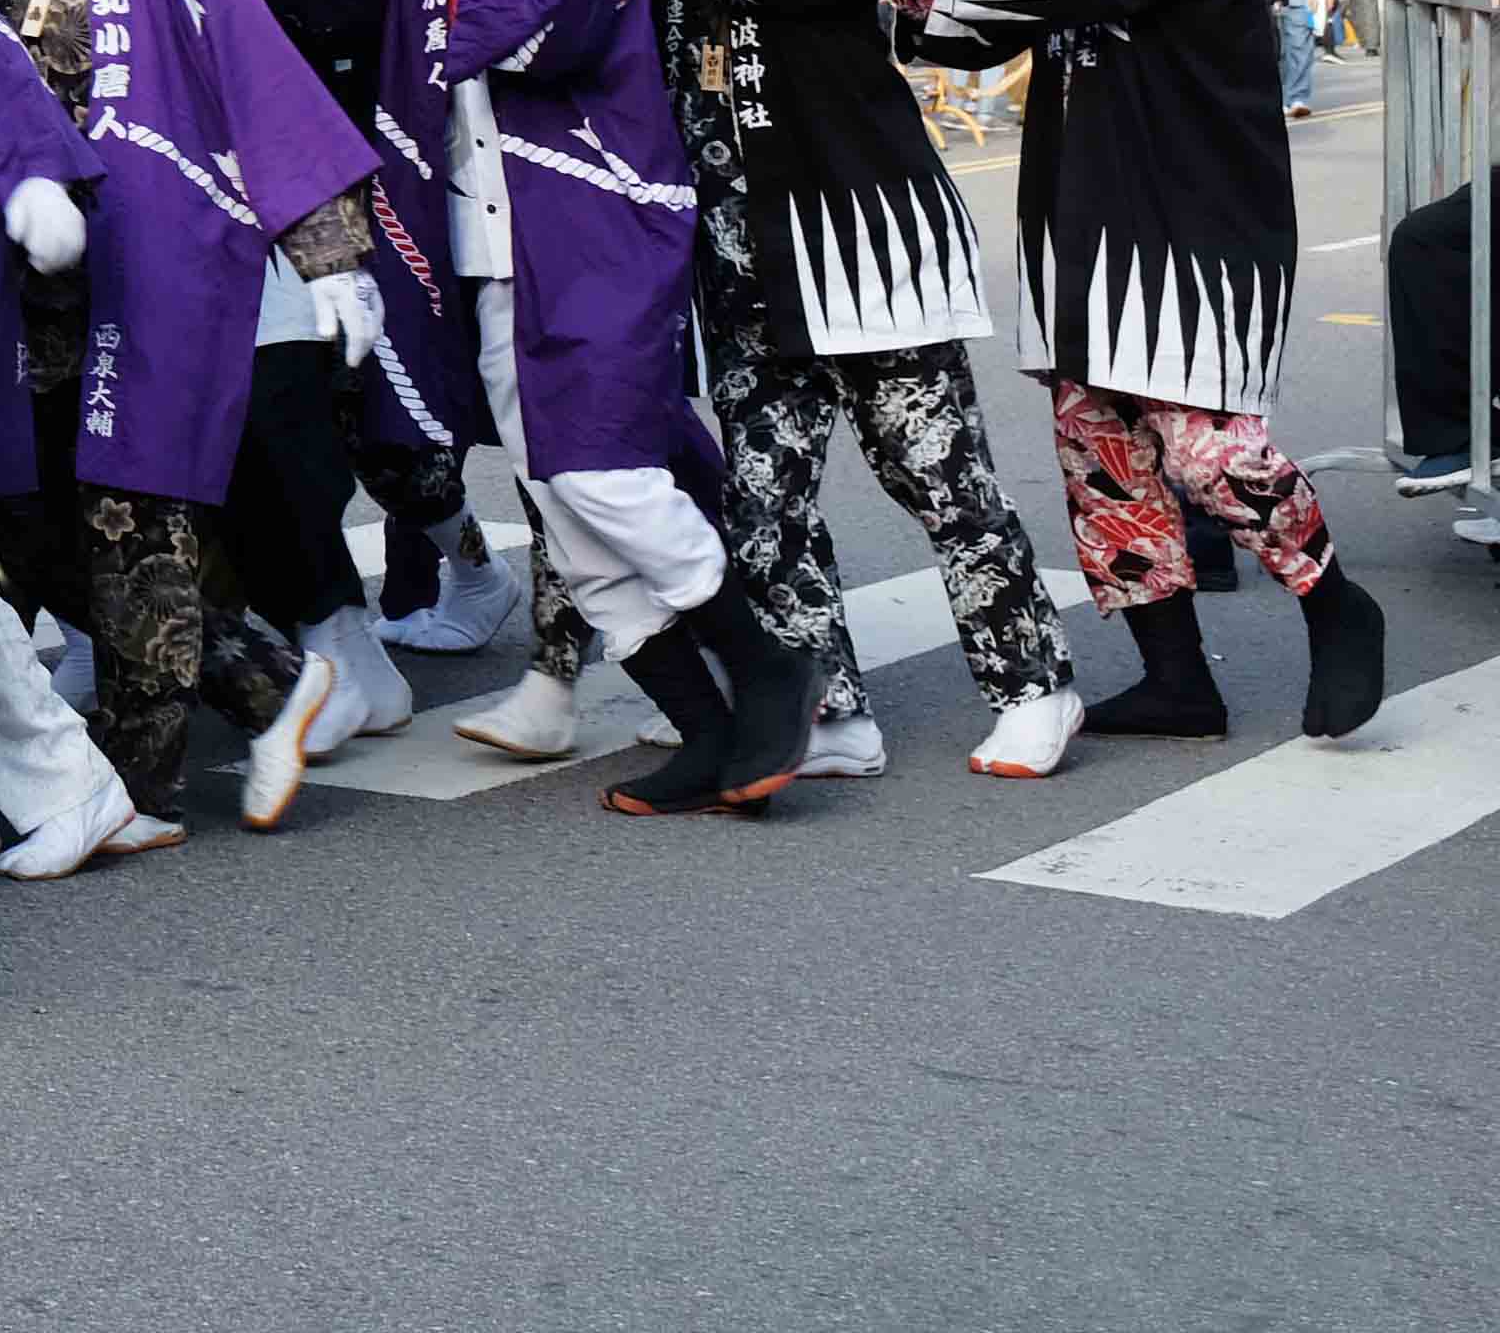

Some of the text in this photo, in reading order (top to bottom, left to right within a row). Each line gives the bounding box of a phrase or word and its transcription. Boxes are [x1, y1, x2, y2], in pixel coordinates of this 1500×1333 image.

[730, 16, 773, 129] 波神社
[84, 322, 122, 439] 西泉大輔
